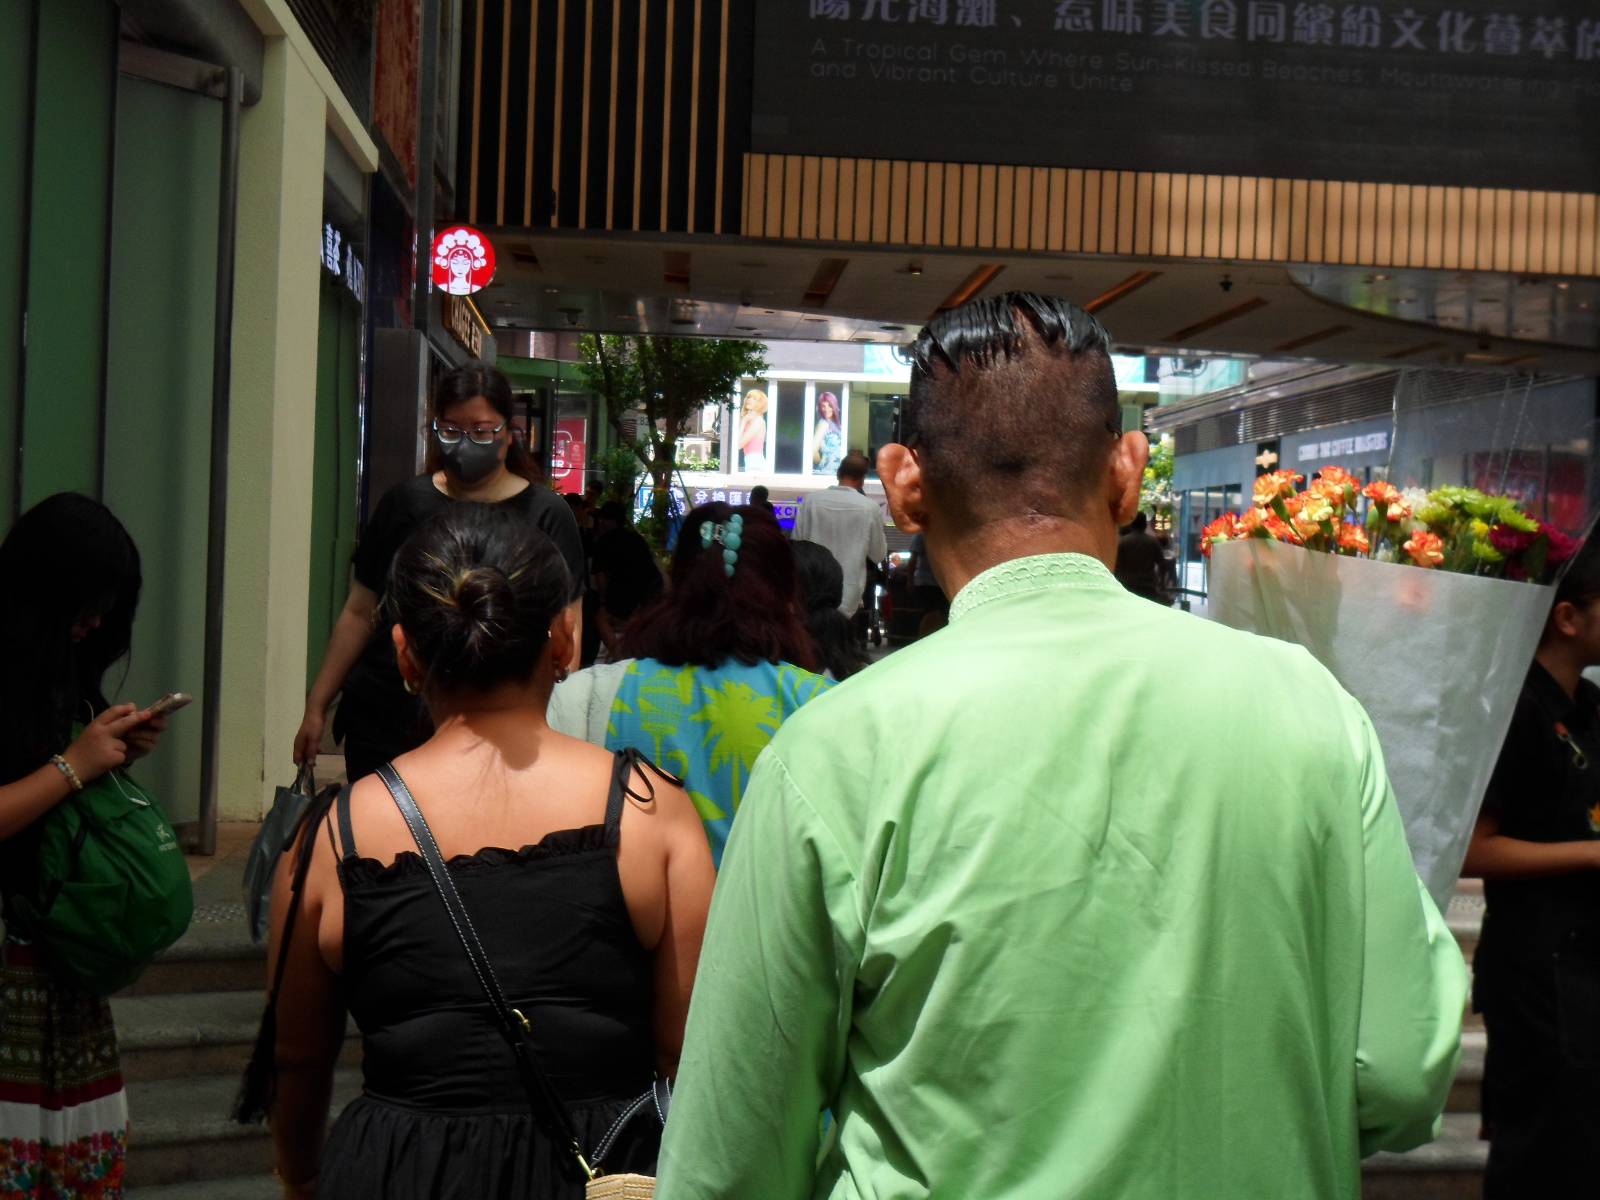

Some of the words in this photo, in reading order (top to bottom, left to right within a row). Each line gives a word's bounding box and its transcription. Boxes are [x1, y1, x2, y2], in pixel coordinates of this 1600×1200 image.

[811, 38, 826, 56] A
[840, 38, 937, 64] Tropical
[949, 43, 1007, 65] Gem
[1019, 48, 1105, 69] Where
[811, 61, 857, 79] and
[870, 62, 957, 83] Vibrant
[969, 66, 1058, 88] Culture
[1071, 71, 1134, 92] Unite
